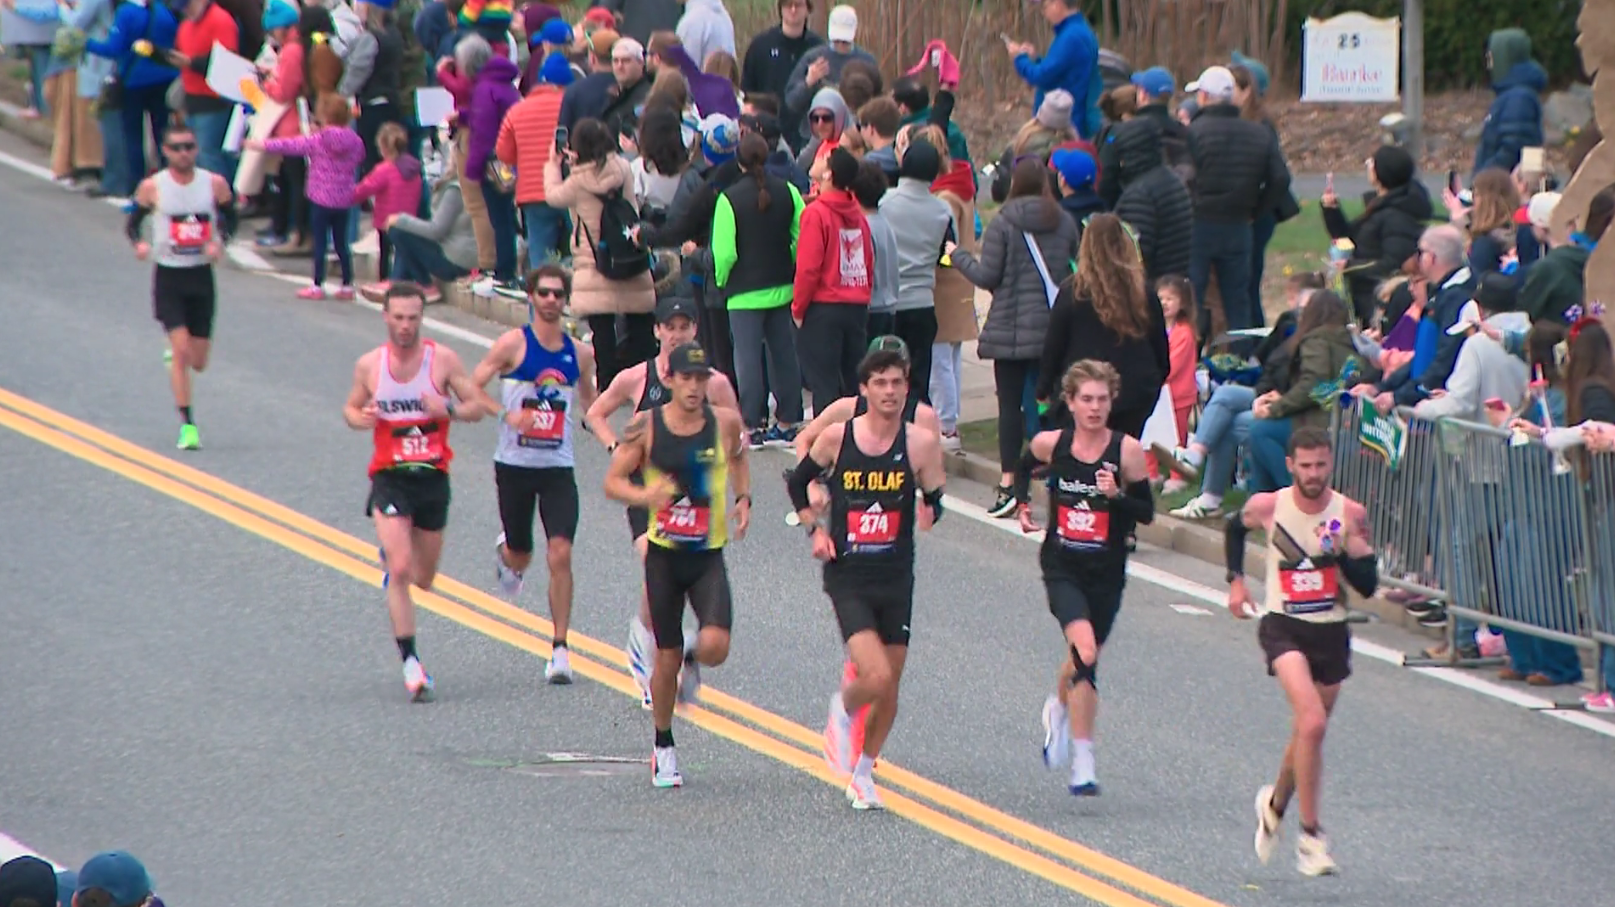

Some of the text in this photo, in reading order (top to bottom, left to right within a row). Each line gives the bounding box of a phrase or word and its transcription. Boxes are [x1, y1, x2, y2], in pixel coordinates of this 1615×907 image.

[402, 436, 429, 456] 512
[842, 470, 906, 491] ST. OLAF
[1058, 477, 1102, 497] baleg
[859, 513, 889, 535] 374
